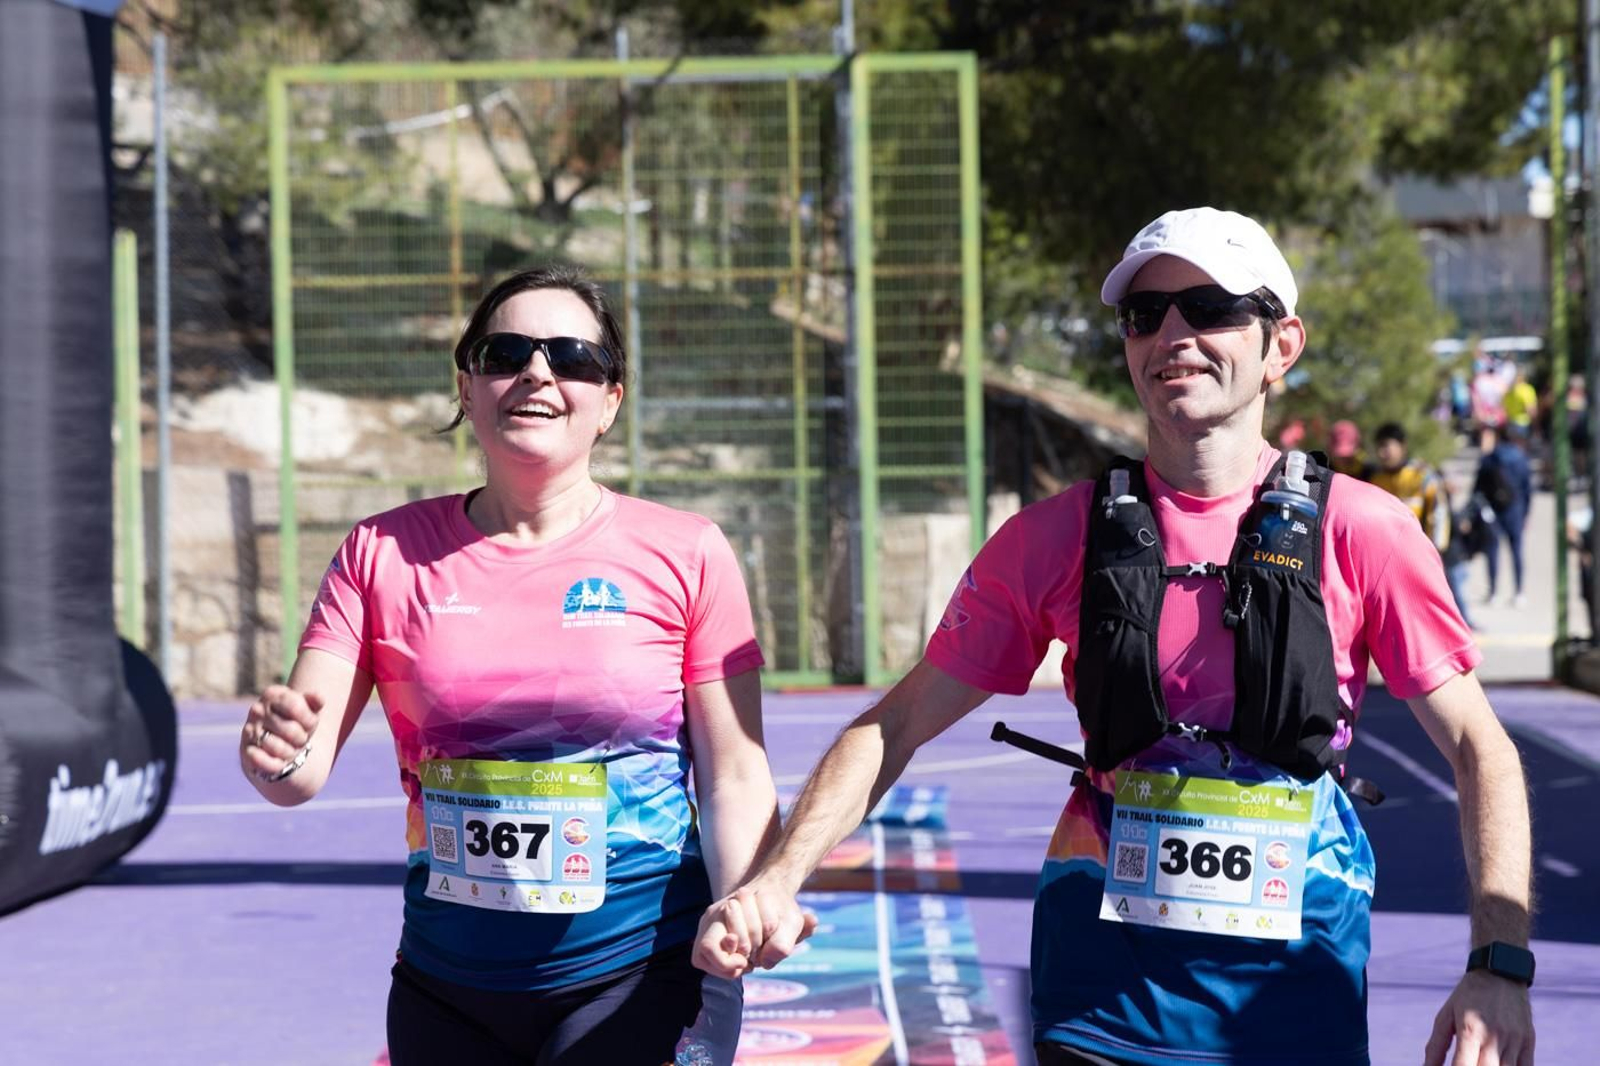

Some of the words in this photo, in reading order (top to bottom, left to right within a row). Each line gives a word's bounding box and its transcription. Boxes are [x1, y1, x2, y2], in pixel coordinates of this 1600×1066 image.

[1253, 550, 1304, 570] EVADICT
[532, 770, 562, 784] CxM
[530, 784, 562, 796] 2025
[1240, 790, 1270, 805] CxM
[425, 792, 436, 802] VII
[436, 794, 456, 805] TRAIL
[458, 796, 500, 809] SOLIDARIO
[528, 801, 563, 811] FUENTE
[564, 802, 579, 812] LA
[1238, 804, 1268, 818] 2025
[1116, 809, 1128, 819] VII
[1130, 812, 1153, 824] TRAIL
[1156, 814, 1204, 828] SOLIDARIO
[1269, 824, 1282, 836] LA
[466, 820, 550, 860] 367
[1159, 838, 1252, 882] 366
